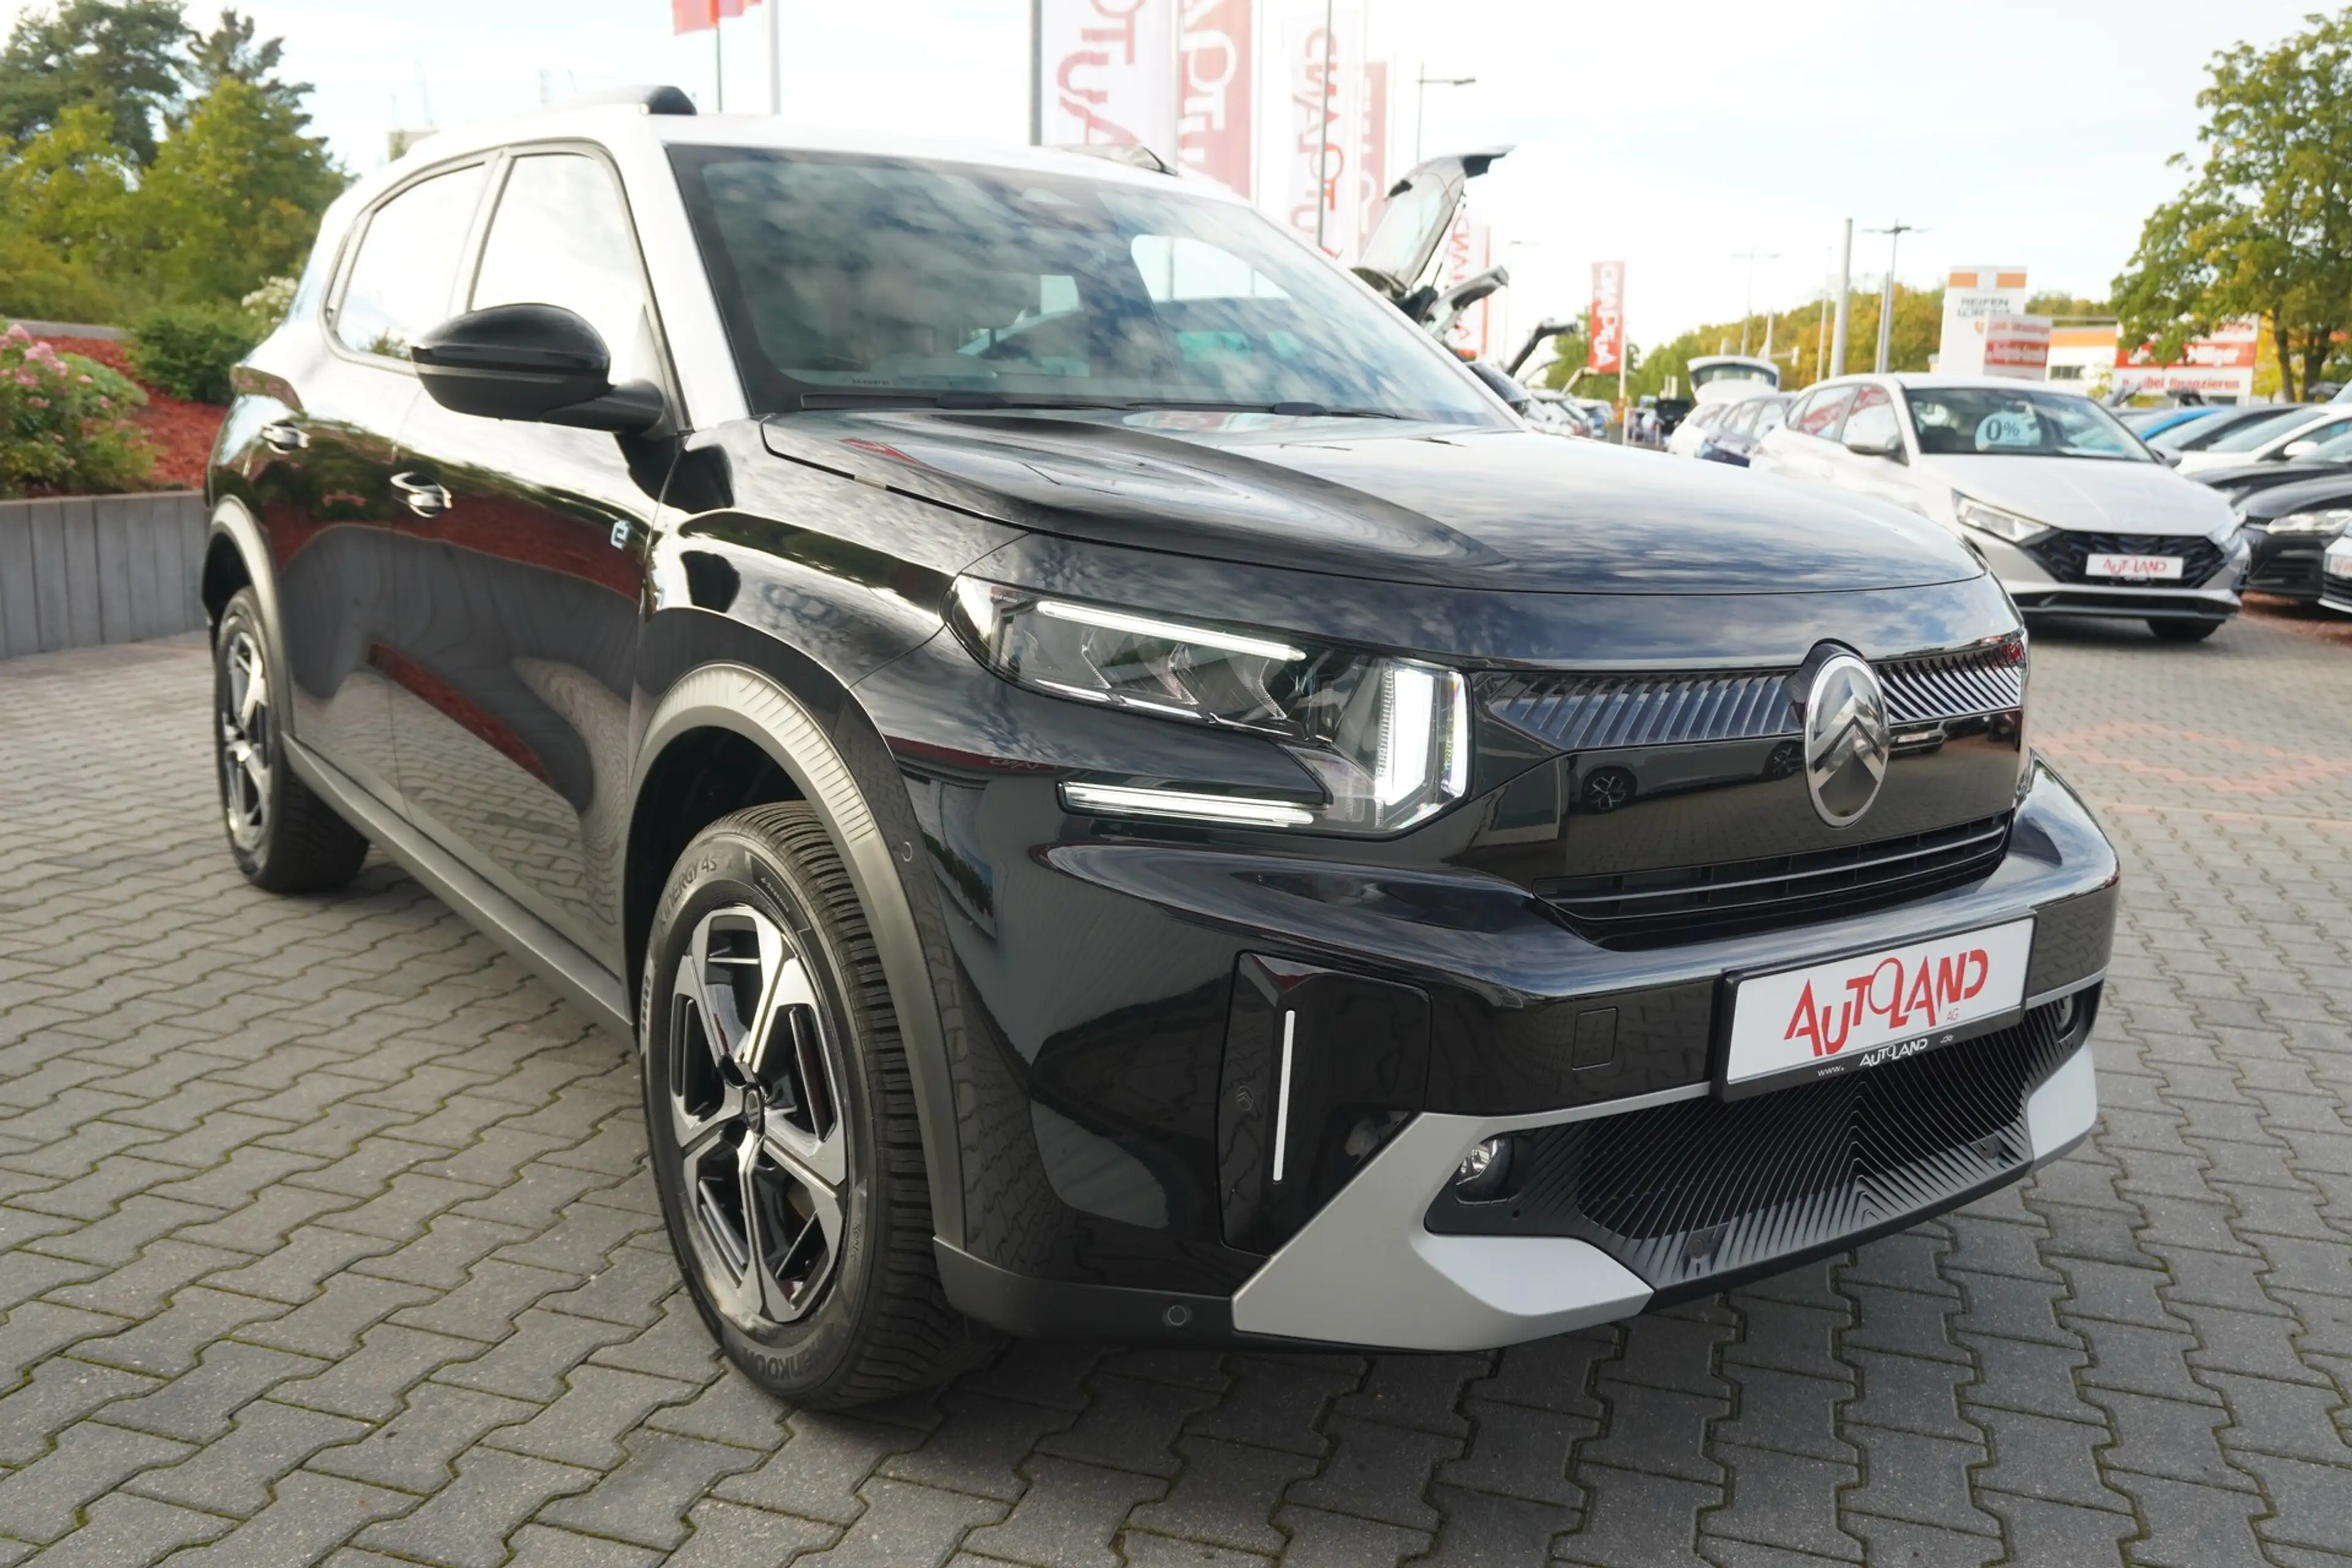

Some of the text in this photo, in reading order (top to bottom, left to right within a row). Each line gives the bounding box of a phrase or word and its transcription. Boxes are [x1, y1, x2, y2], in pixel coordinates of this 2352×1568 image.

[1985, 419, 2021, 442] 0%
[1784, 949, 1988, 1057] AUTOLAND
[1945, 1008, 1959, 1022] AG
[1817, 1065, 1845, 1076] www.
[1859, 1038, 1928, 1067] AUTOLAND
